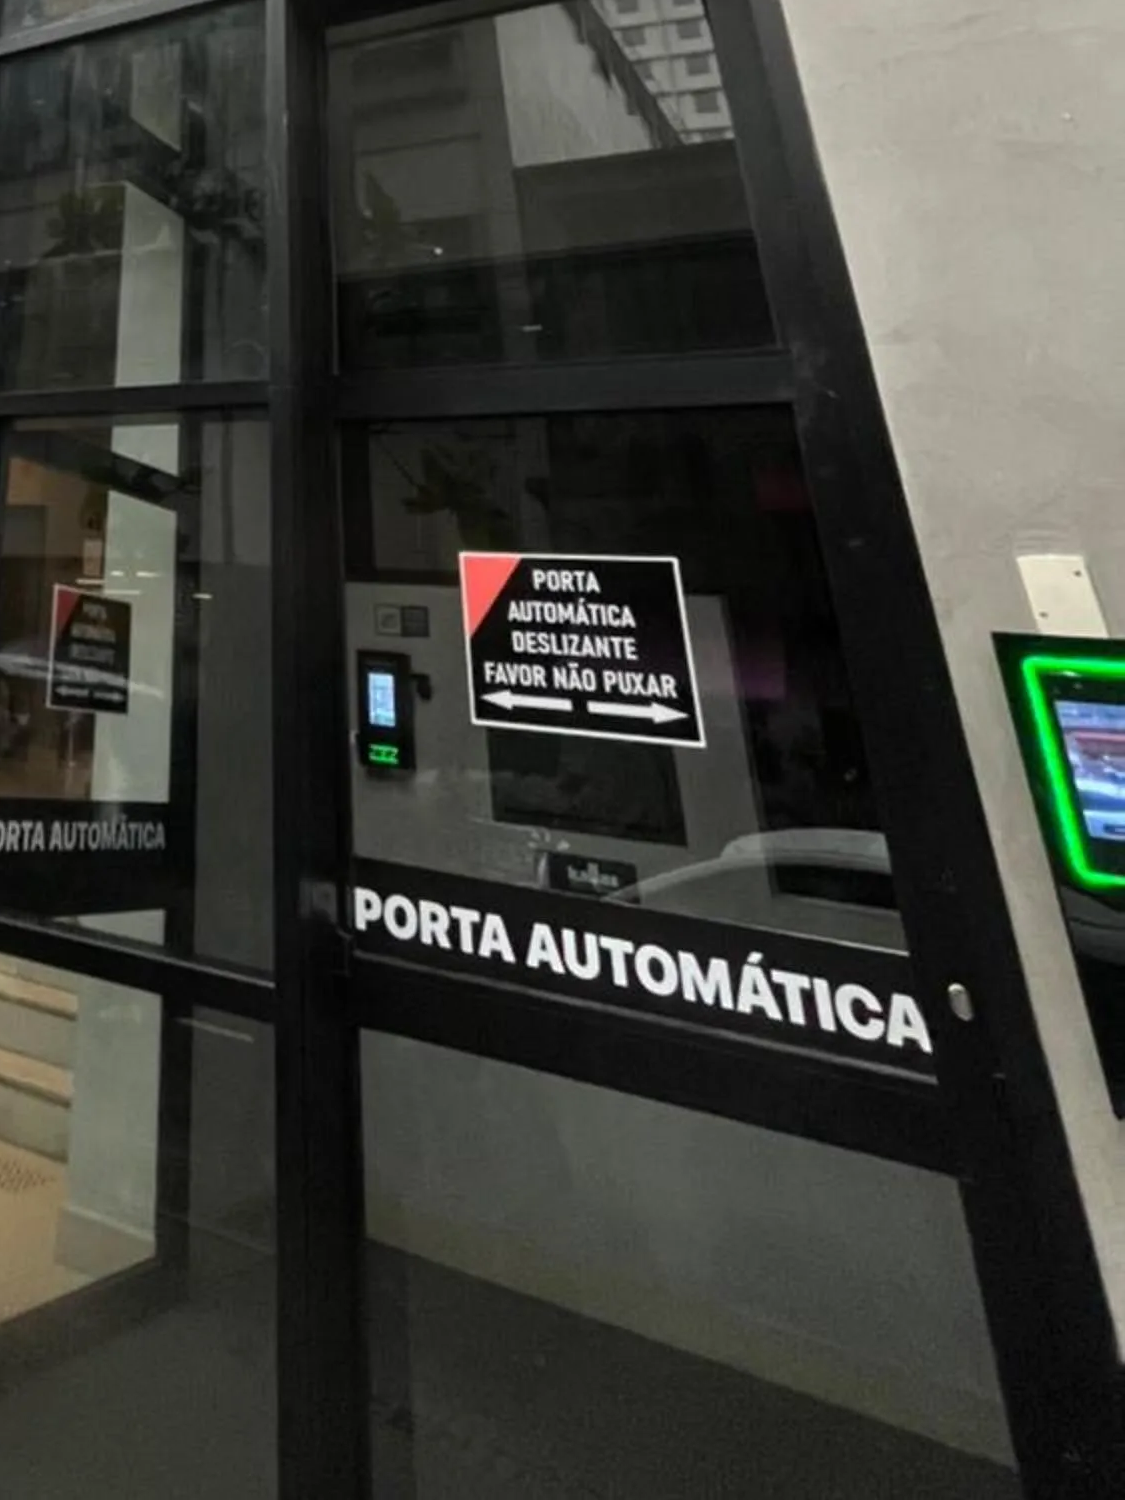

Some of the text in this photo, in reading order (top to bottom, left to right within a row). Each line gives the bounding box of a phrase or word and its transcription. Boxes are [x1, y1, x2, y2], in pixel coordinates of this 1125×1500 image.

[532, 569, 601, 594] PORTA
[507, 597, 636, 628] AUTOMÁTICA
[511, 630, 639, 661] DESLIZANTE
[483, 661, 679, 699] FAVOR NÃO PUXAR
[49, 814, 166, 850] AUTOMÁTICA
[353, 886, 933, 1055] PORTA AUTOMÁTICA
